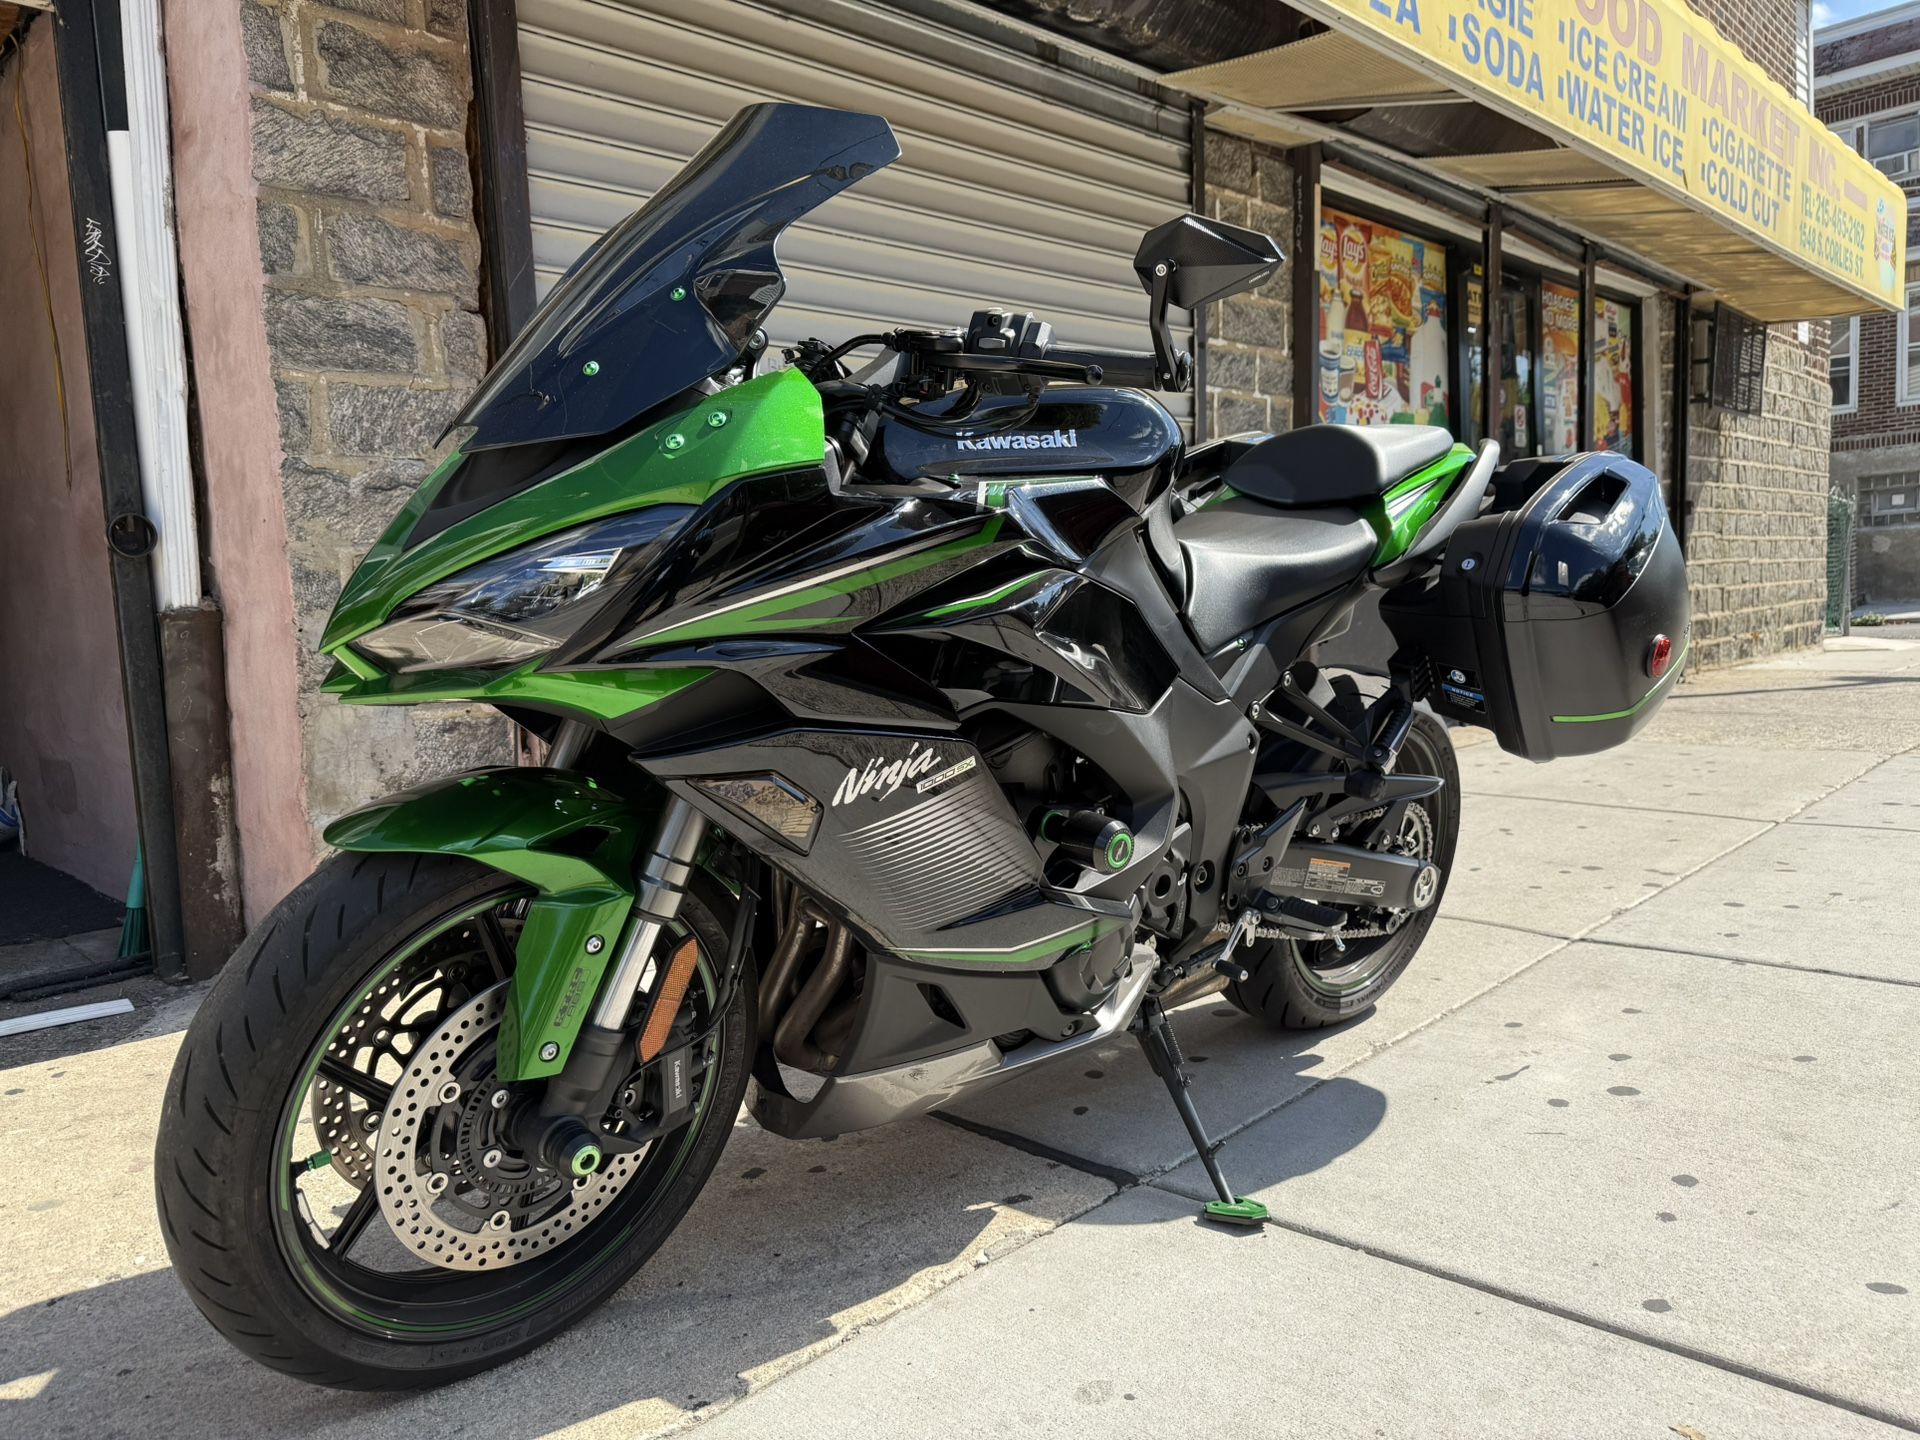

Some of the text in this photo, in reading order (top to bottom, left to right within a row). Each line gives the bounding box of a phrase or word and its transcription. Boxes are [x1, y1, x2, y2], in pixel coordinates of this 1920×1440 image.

[1462, 13, 1544, 101] SODA
[1569, 18, 1687, 133] ICE CREAM
[1681, 32, 1800, 168] MARKET
[1566, 69, 1684, 176] WATER ICE
[1708, 117, 1791, 202] CIGARETTE
[1707, 159, 1780, 232] COLD CUT
[956, 429, 1077, 450] Kawasaki
[832, 742, 941, 806] Ninja
